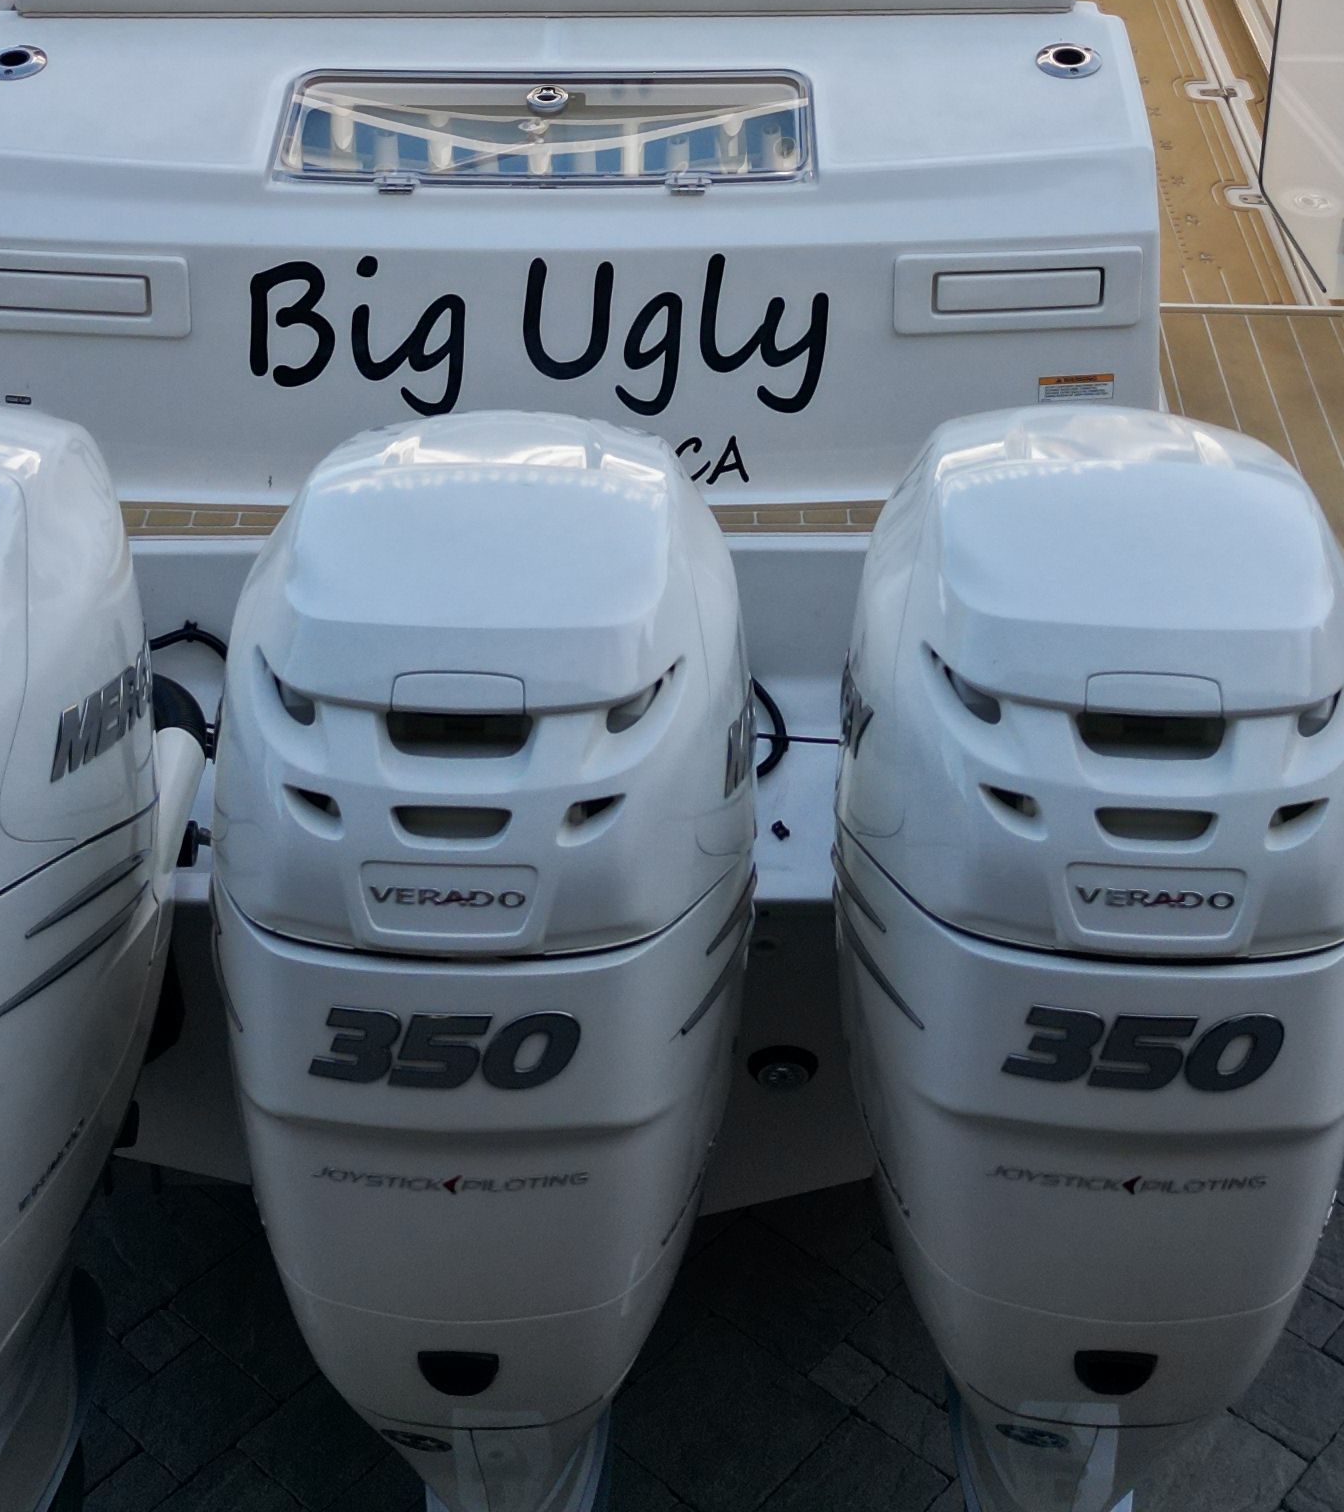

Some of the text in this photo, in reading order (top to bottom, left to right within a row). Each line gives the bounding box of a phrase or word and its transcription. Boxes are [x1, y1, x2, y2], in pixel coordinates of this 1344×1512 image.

[250, 253, 829, 416] Big Ugly
[675, 434, 750, 485] CA
[368, 885, 526, 909] VERADO
[1076, 885, 1235, 910] VERADO
[308, 1004, 582, 1091] 350
[1001, 1004, 1286, 1093] 350
[312, 1165, 591, 1193] JOYSTICK PILOTING
[985, 1164, 1269, 1194] JOYSTICK PILOTING
